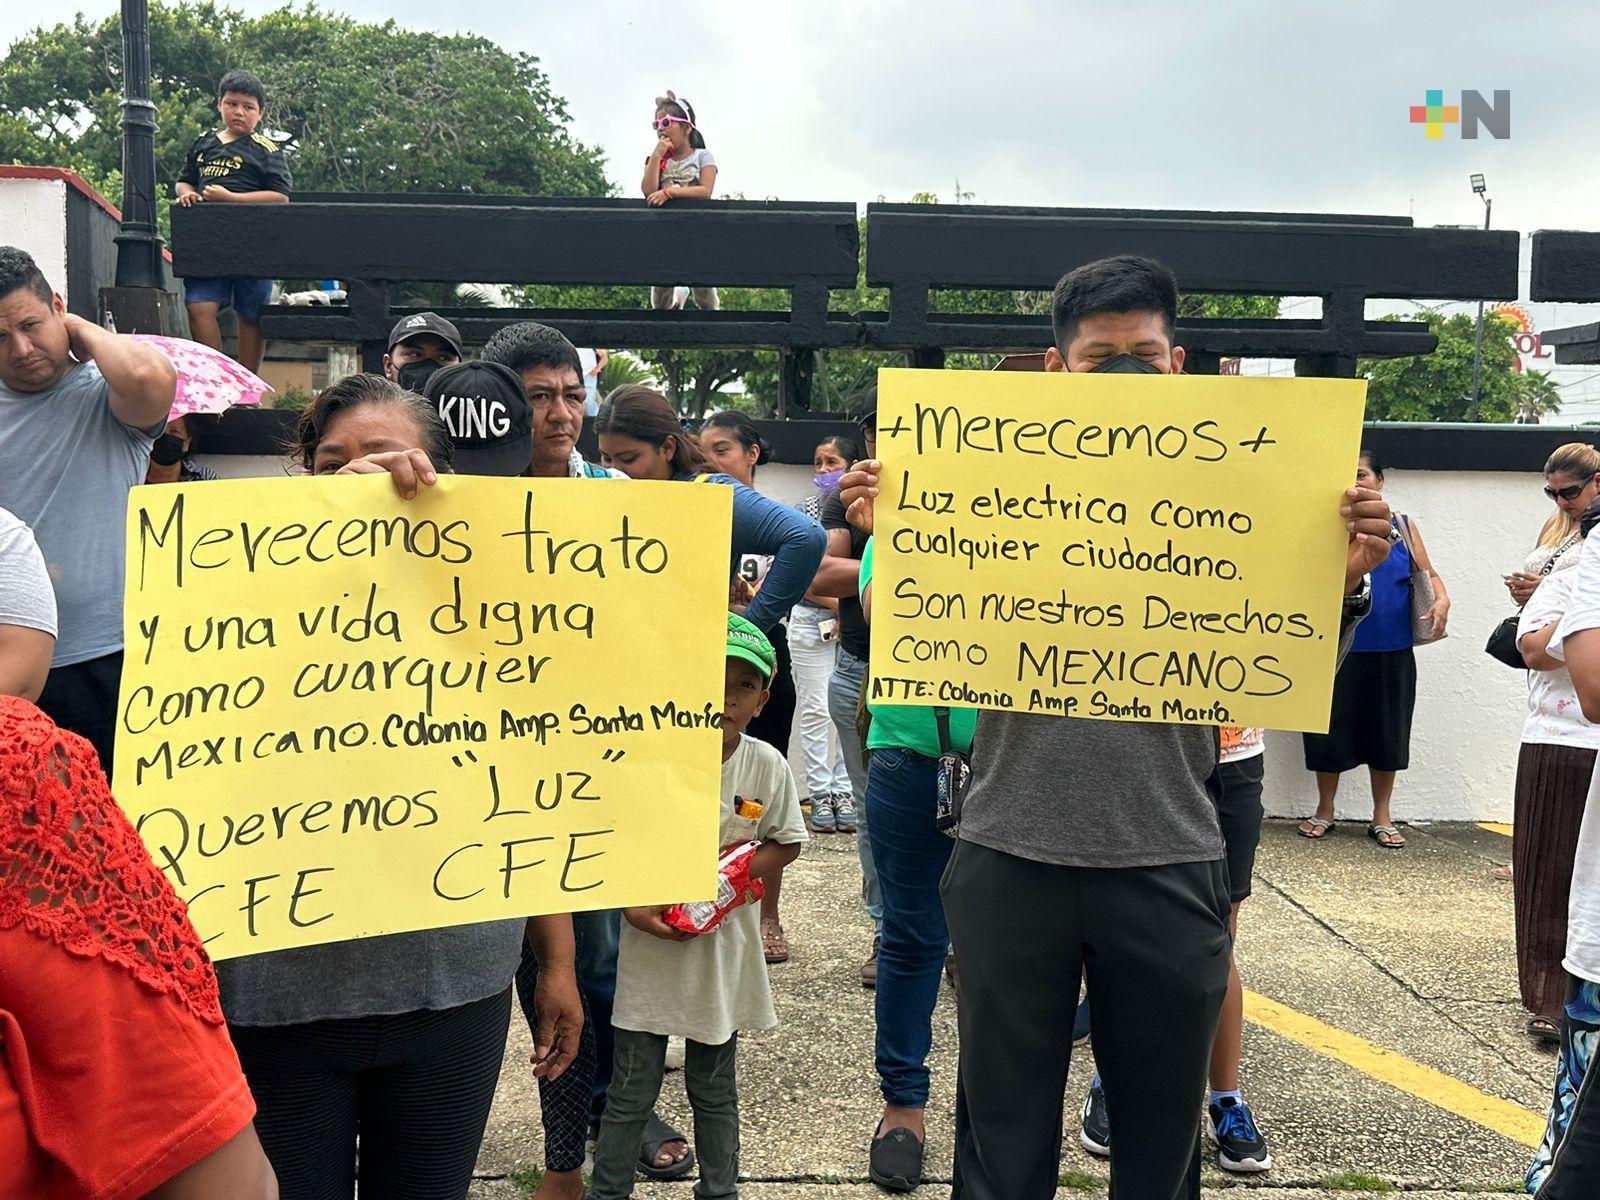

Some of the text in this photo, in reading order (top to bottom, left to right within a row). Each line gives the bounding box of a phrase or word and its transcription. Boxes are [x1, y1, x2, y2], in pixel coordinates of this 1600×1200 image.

[1510, 333, 1552, 358] OL
[438, 394, 511, 439] KING
[898, 470, 956, 514] Luz
[970, 483, 1127, 525] electrica
[139, 491, 668, 592] Merecemos trato
[892, 526, 1244, 581] cualquier ciudadano.
[742, 558, 758, 582] 9
[184, 616, 276, 653] una
[298, 582, 402, 643] vida
[430, 576, 594, 646] digna
[893, 577, 1324, 640] Son nuestros Derechos.
[1017, 641, 1293, 697] MEXICANOS
[500, 709, 561, 745] Amp.
[568, 703, 644, 735] Santa
[650, 701, 724, 729] María
[871, 677, 935, 700] ATTE:
[937, 680, 1014, 708] Colonia
[1027, 689, 1079, 718] Amp.
[1088, 691, 1151, 718] Santa
[136, 790, 438, 886] Queremos
[433, 829, 615, 900] CFE
